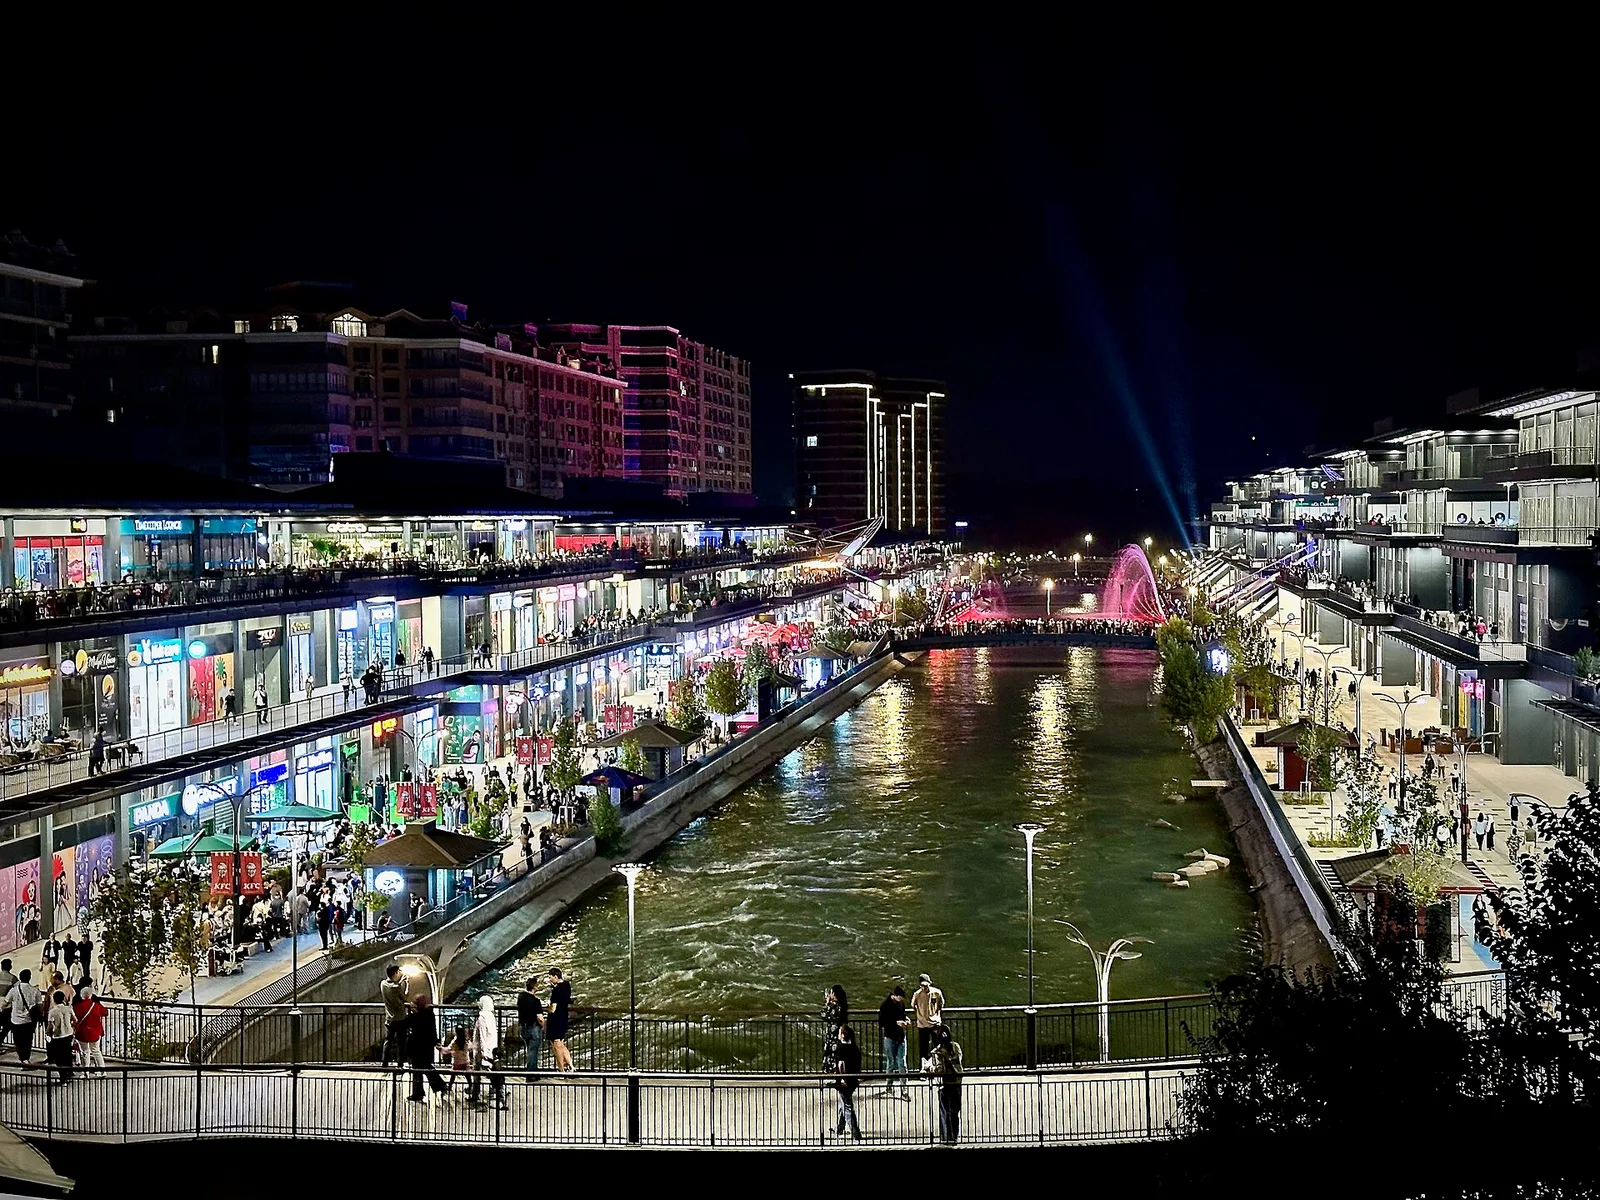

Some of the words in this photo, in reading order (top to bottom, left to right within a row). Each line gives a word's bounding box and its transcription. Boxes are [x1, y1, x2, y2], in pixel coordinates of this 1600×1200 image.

[133, 799, 169, 825] PANDA
[213, 882, 231, 890] KFC
[243, 882, 260, 890] KFC
